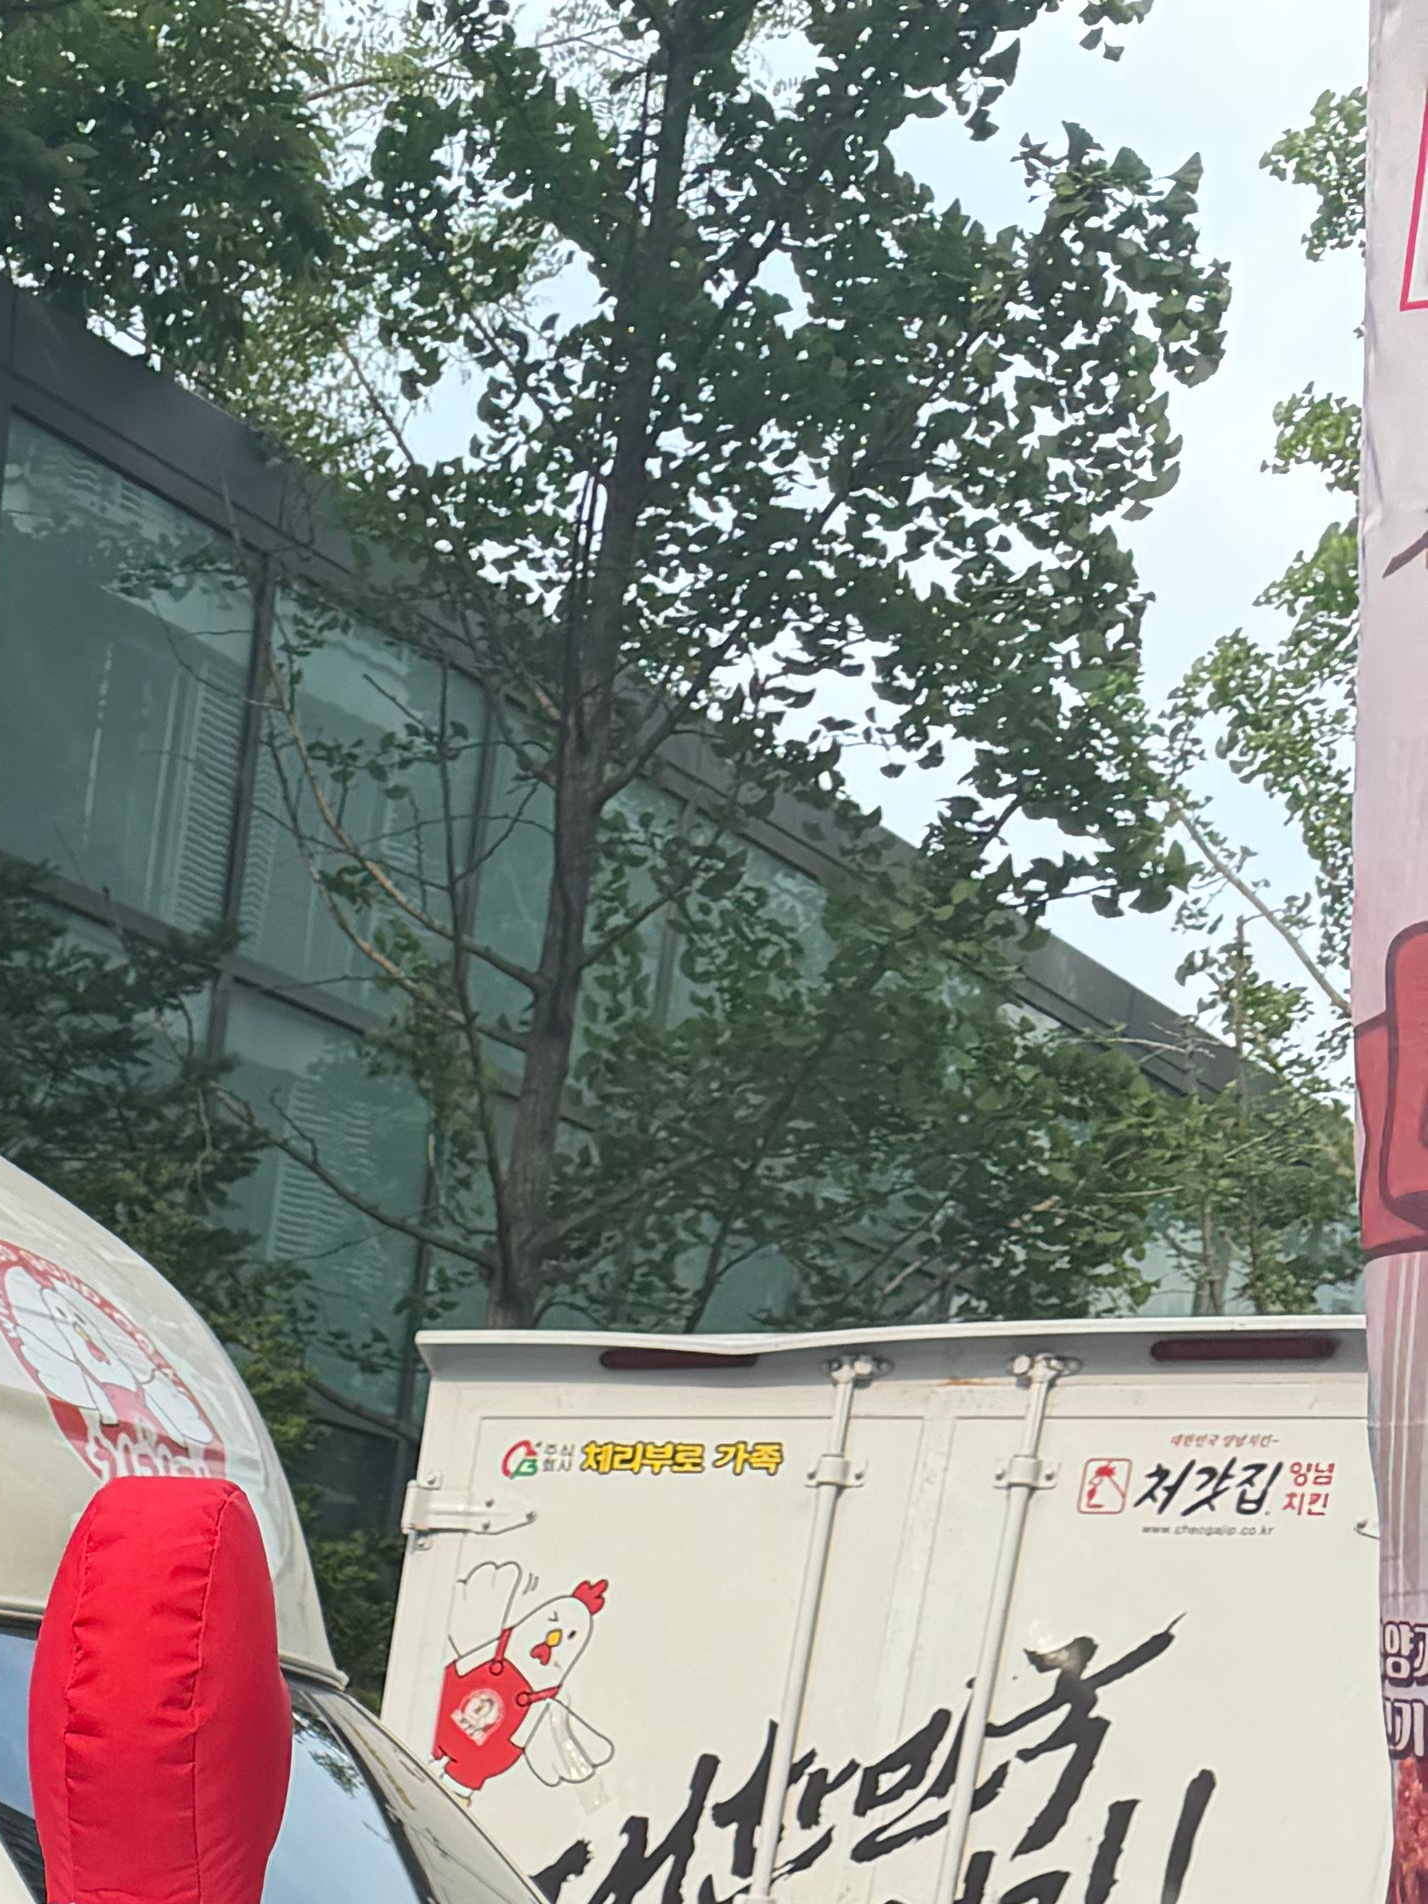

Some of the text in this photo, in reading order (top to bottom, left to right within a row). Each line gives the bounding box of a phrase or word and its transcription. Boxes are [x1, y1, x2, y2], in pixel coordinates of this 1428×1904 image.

[579, 1440, 785, 1476] 체리부로 가족
[1132, 1456, 1284, 1518] 처갓집
[1288, 1461, 1336, 1488] 양념
[1282, 1492, 1331, 1517] 치킨
